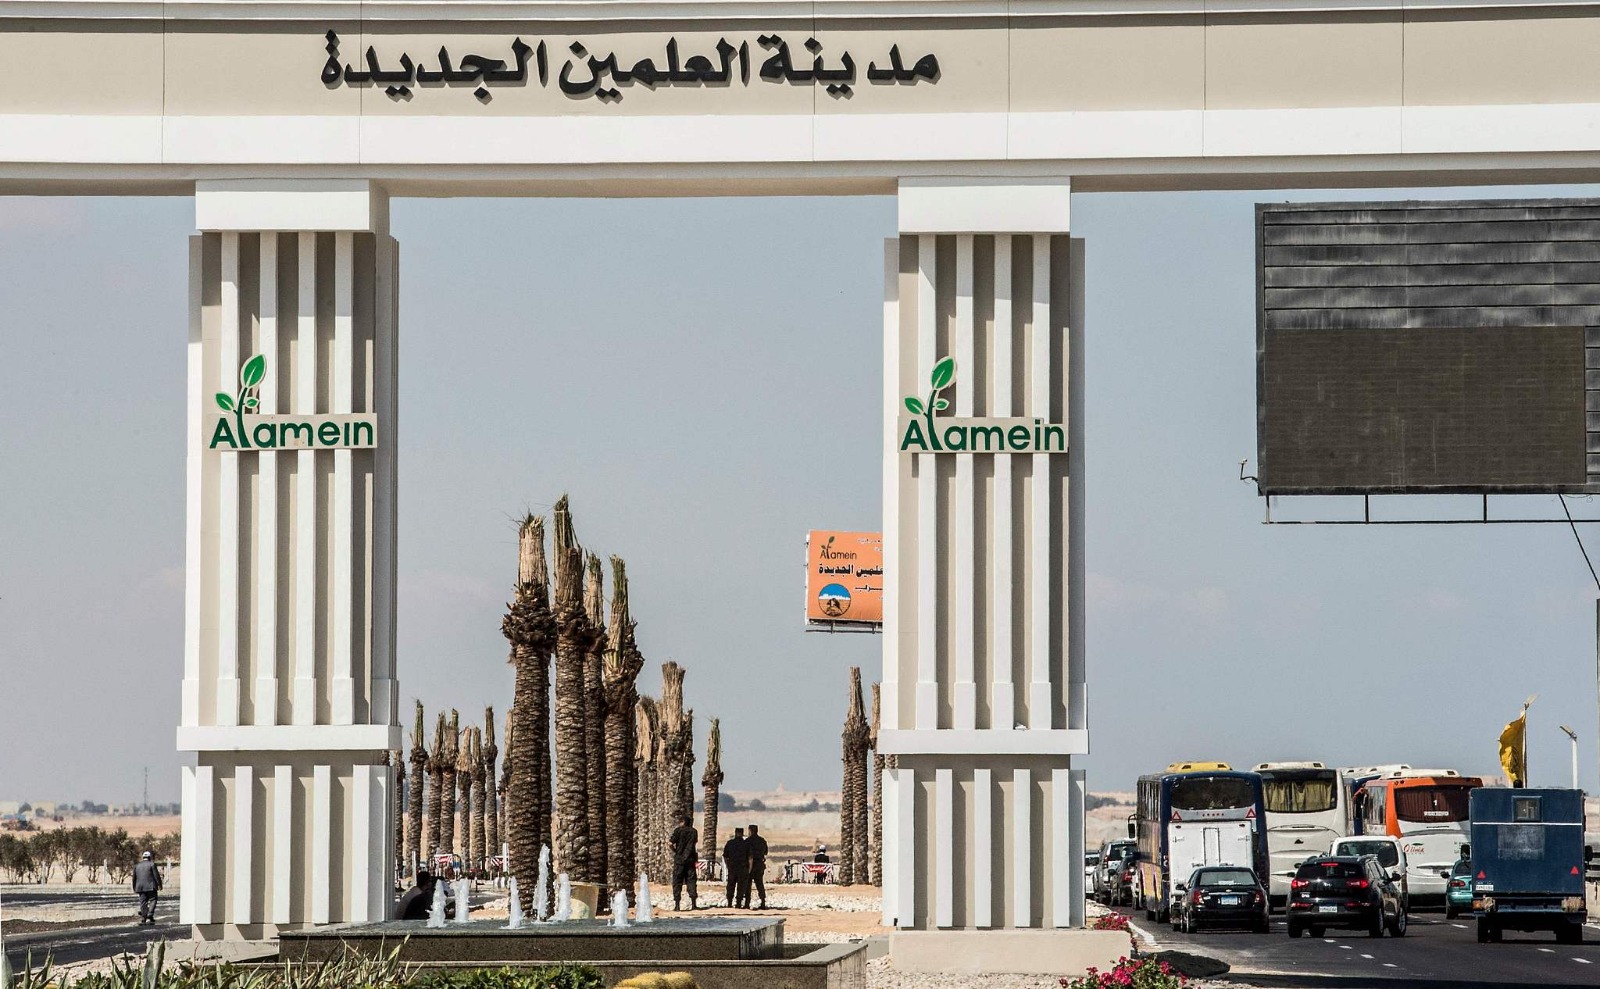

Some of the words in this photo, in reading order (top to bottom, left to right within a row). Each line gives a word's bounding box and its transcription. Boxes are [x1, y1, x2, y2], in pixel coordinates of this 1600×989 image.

[319, 29, 547, 100] الجديدة
[558, 36, 749, 100] العلمين
[757, 34, 941, 95] مدينة
[210, 387, 374, 448] Alamein
[901, 389, 1064, 451] Alamein
[819, 564, 853, 577] الجديدة
[820, 544, 857, 559] Alamein
